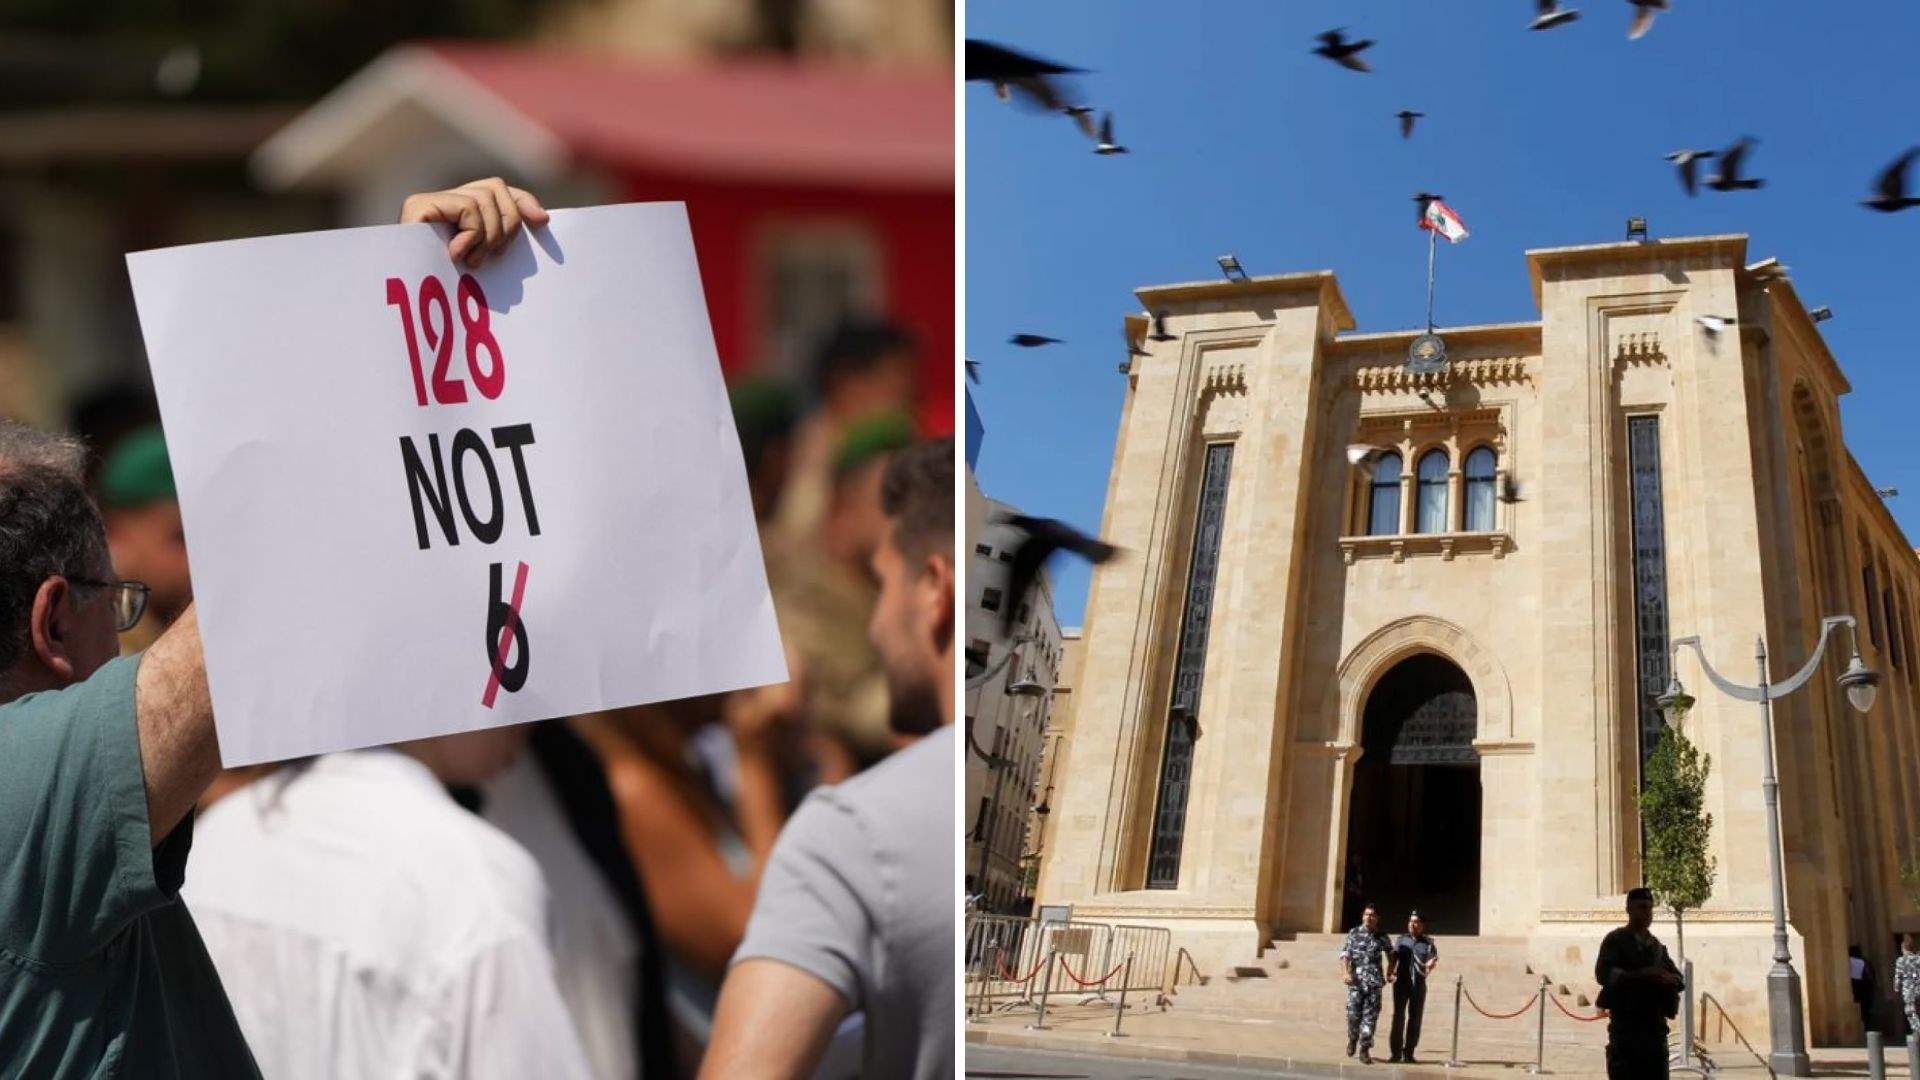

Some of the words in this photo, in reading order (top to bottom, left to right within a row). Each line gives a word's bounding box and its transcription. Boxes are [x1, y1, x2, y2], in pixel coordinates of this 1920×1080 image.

[386, 273, 505, 407] 128
[399, 423, 541, 550] NOT
[485, 561, 530, 694] 6
